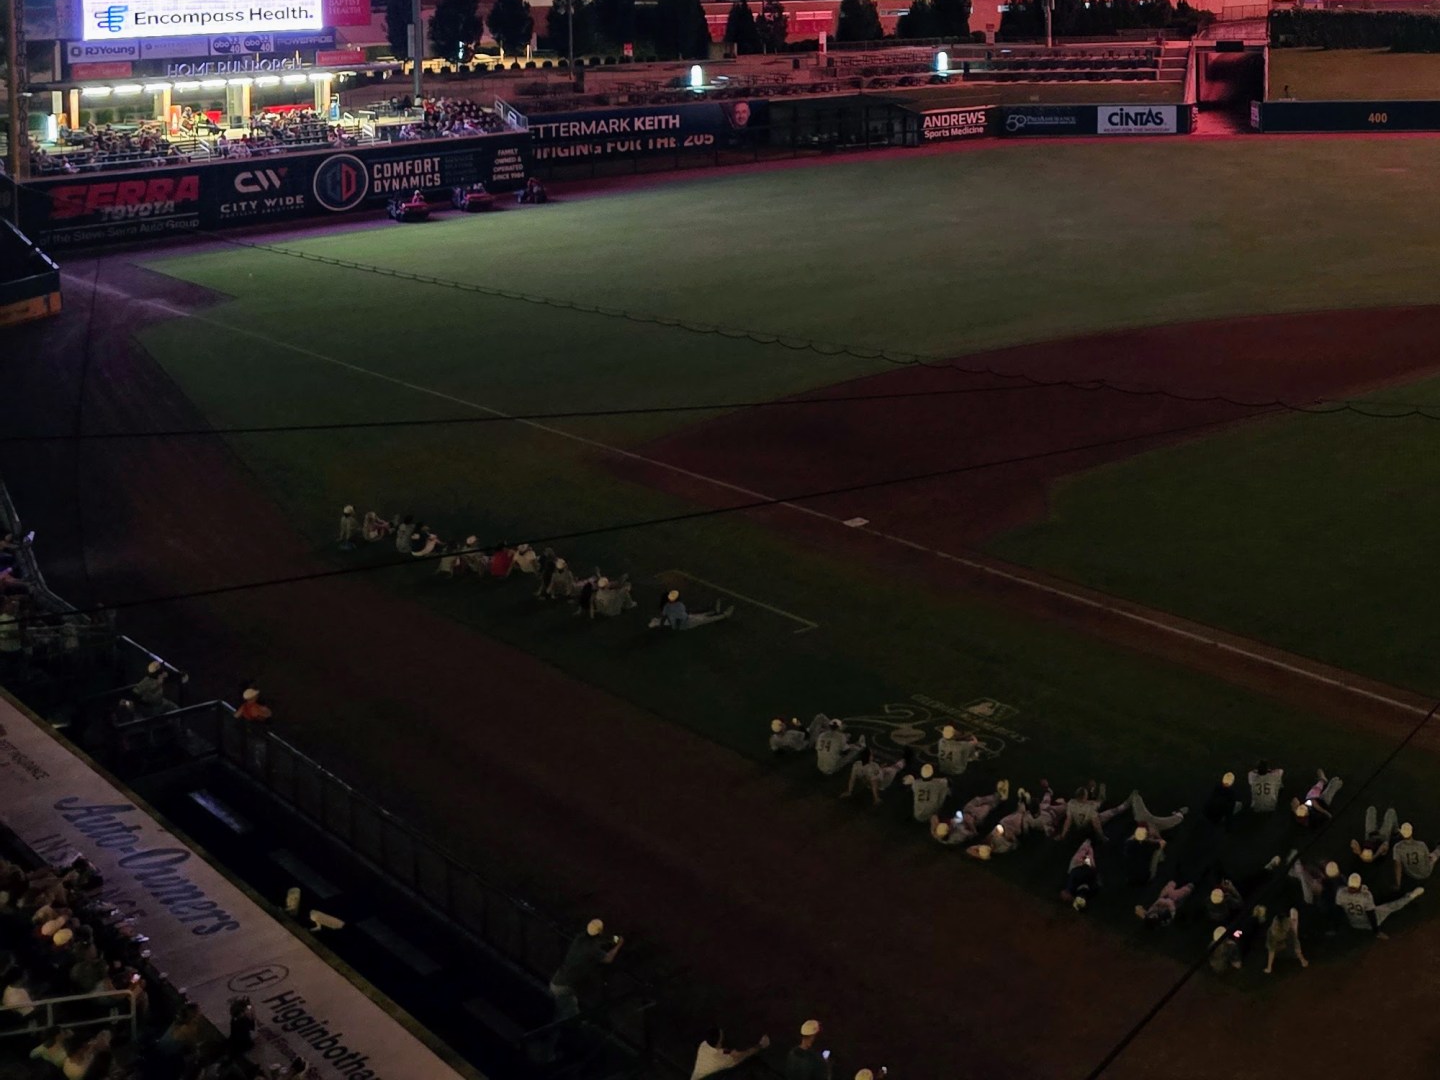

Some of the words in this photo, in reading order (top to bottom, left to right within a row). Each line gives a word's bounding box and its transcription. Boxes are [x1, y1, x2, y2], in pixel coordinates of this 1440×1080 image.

[134, 10, 244, 26] Encompass
[167, 63, 213, 78] HOME
[215, 60, 248, 74] RUN
[633, 115, 680, 131] KEITH
[923, 111, 986, 128] ANDREWS
[1368, 112, 1388, 124] 400
[683, 133, 714, 148] 205
[924, 128, 949, 140] Sports
[950, 126, 984, 136] Medicine
[497, 148, 518, 156] FAMILY
[373, 156, 441, 179] COMFORT
[494, 156, 517, 165] OWNED
[493, 164, 524, 173] OPERATED
[373, 172, 441, 193] DYNAMICS
[48, 175, 200, 221] SERRA
[220, 199, 257, 214] CITY
[264, 195, 305, 207] WIDE
[99, 200, 175, 222] TOYOTA
[39, 236, 51, 247] of
[53, 233, 71, 244] the
[107, 226, 138, 237] Serra
[139, 223, 163, 233] Auto
[166, 219, 200, 232] Group
[818, 740, 831, 753] 34
[939, 749, 953, 763] 24
[917, 789, 931, 802] 21
[1253, 782, 1270, 796] 36
[53, 796, 240, 935] Auto-Owners
[1403, 852, 1418, 866] 13
